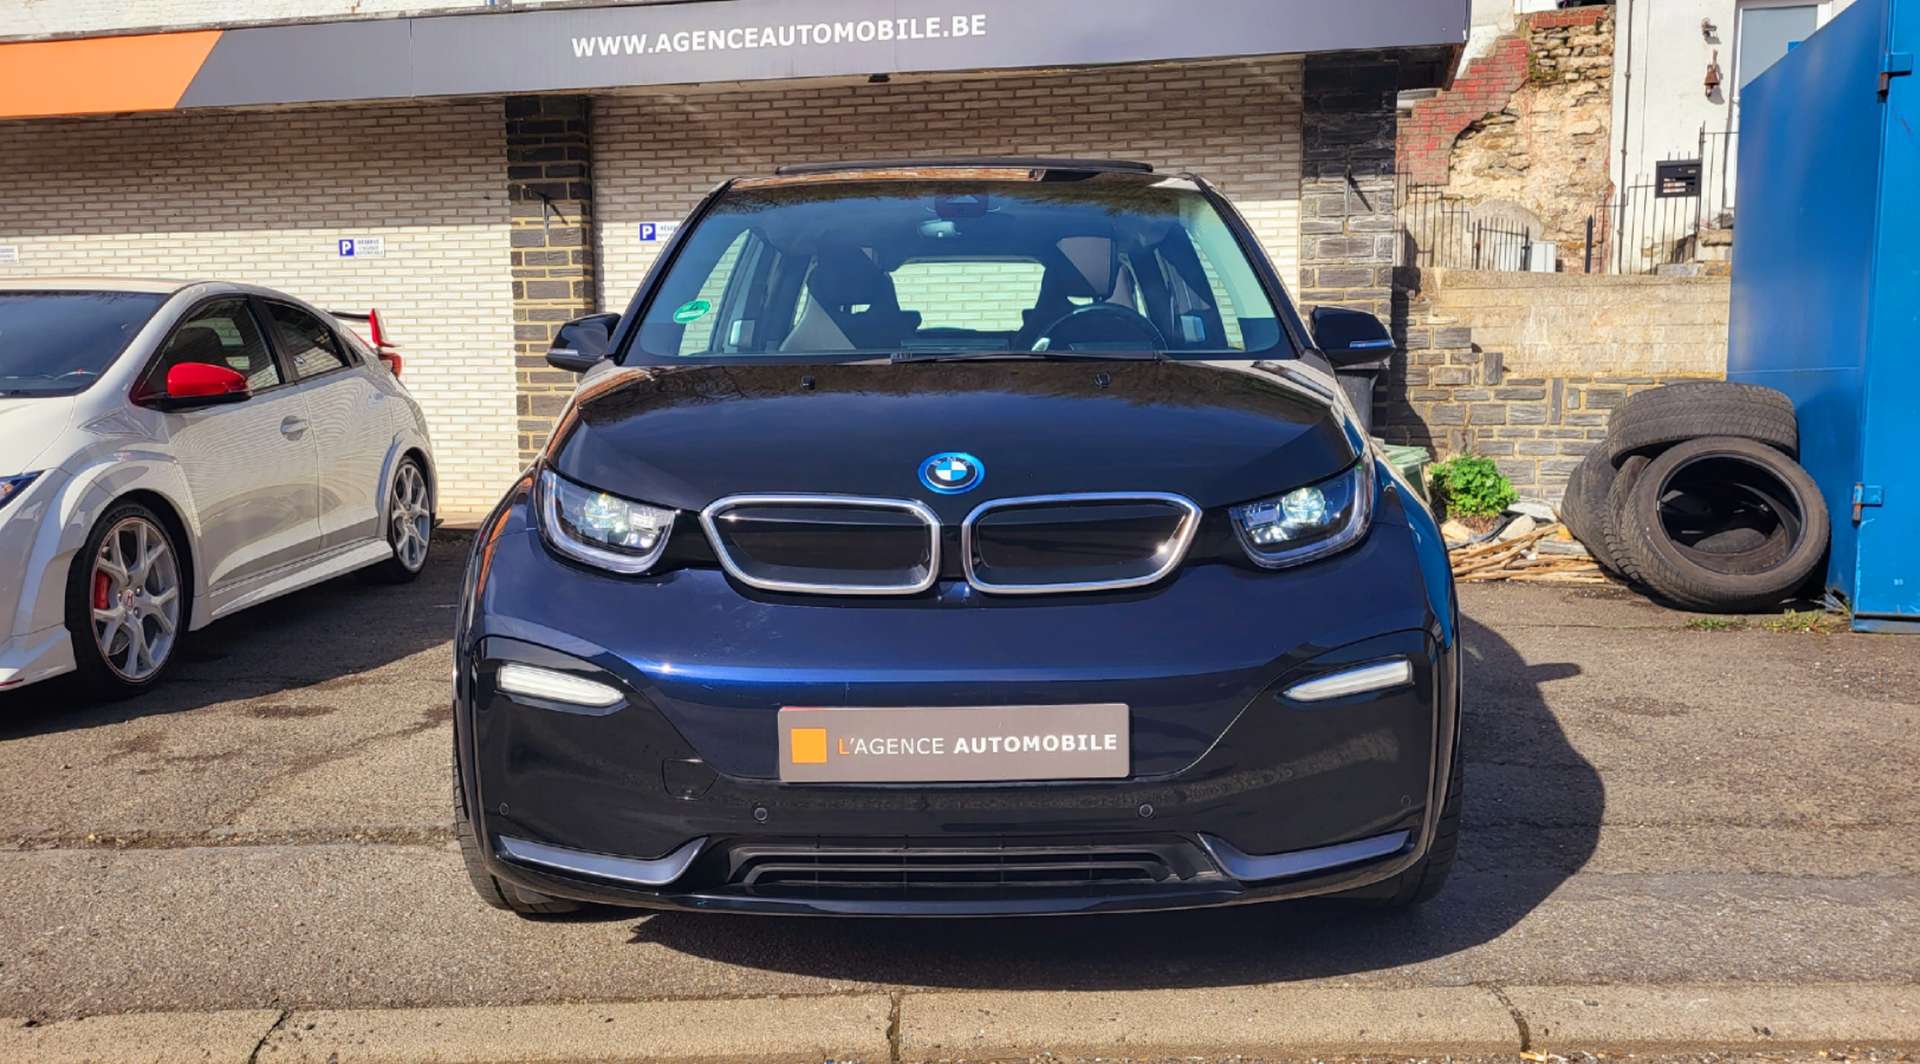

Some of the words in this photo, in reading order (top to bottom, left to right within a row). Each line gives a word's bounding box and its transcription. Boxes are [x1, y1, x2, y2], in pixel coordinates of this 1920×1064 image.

[571, 14, 987, 57] WWW.AGENCEAUTOMOBILE.BE
[838, 737, 945, 755] L'AGENCE
[953, 733, 1118, 754] AUTOMOBILE
